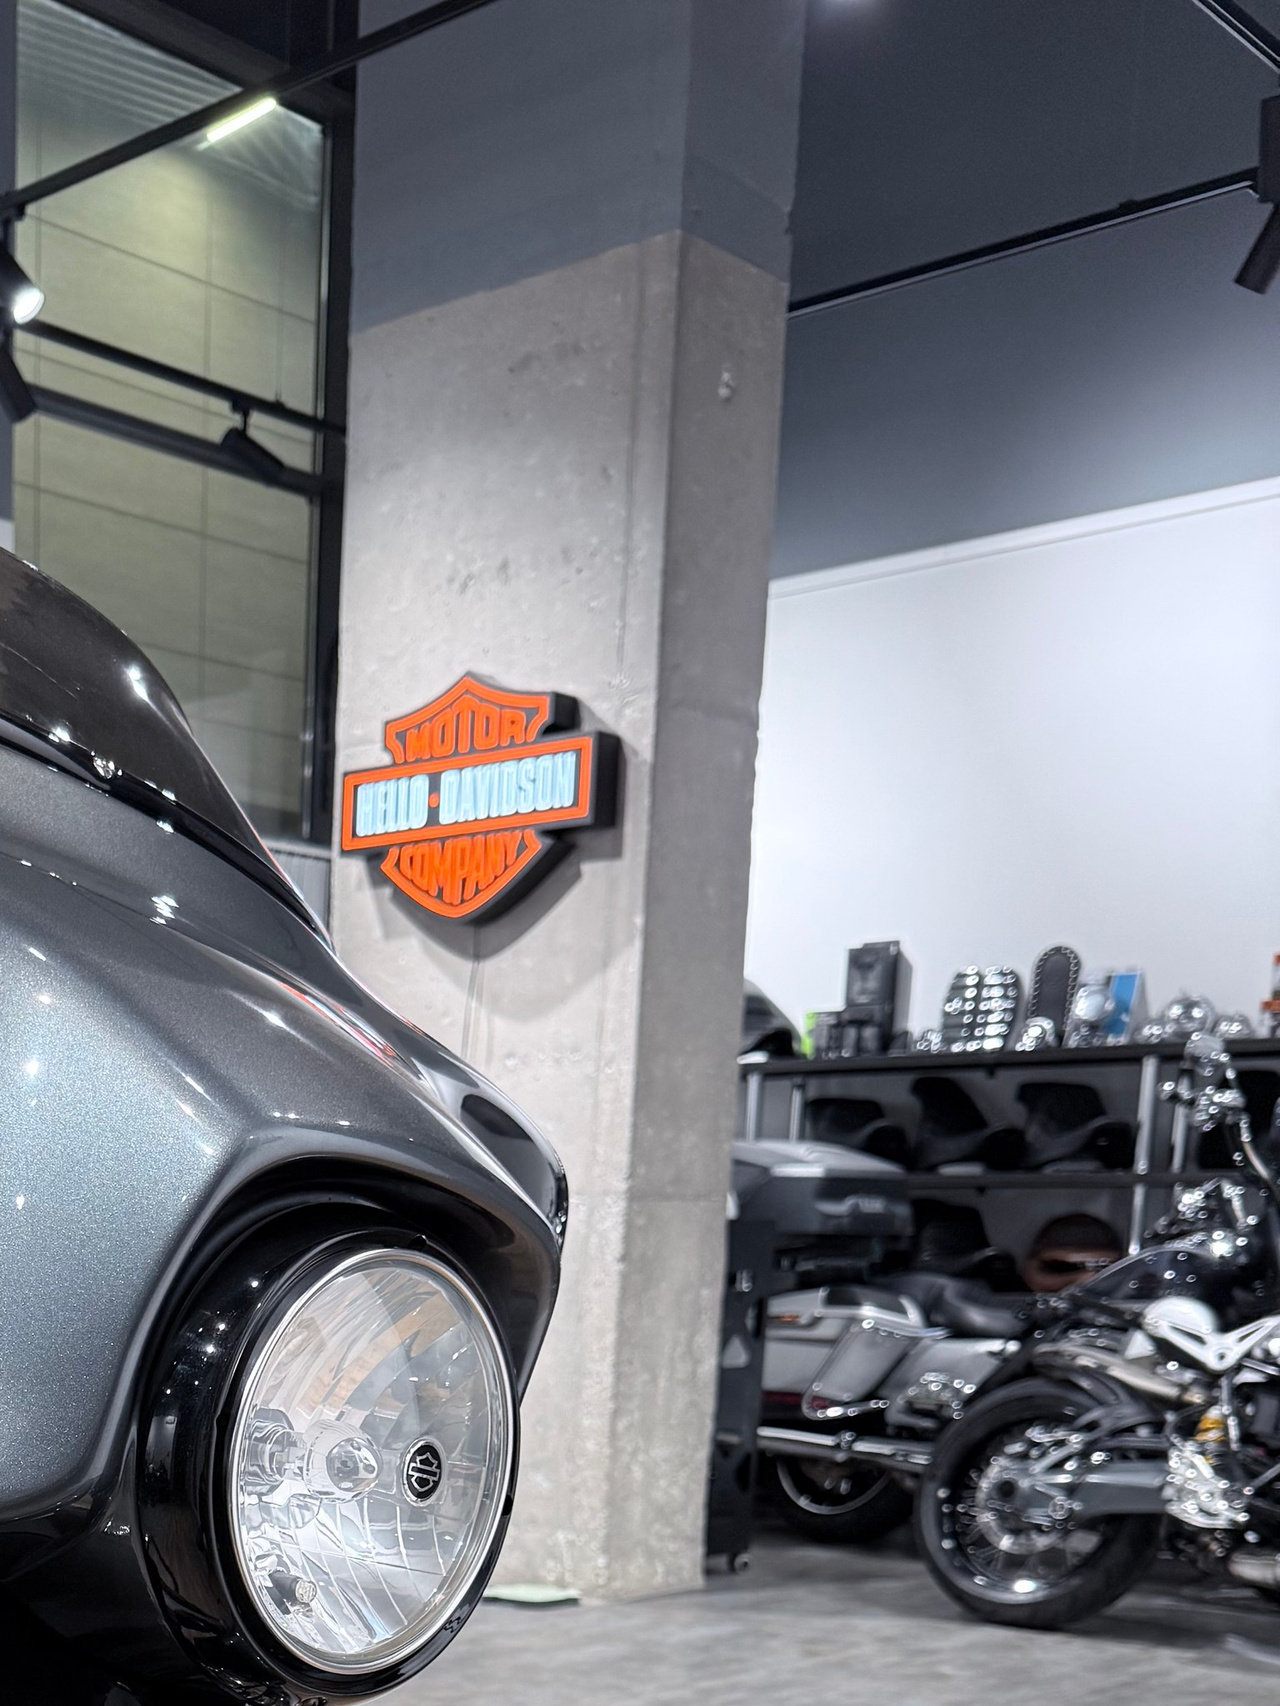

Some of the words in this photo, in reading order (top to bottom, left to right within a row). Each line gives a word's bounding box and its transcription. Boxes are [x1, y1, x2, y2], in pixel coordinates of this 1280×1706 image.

[406, 694, 527, 762] MOTOR
[438, 751, 576, 825] DAVIDSON
[399, 830, 522, 906] COMPANY
